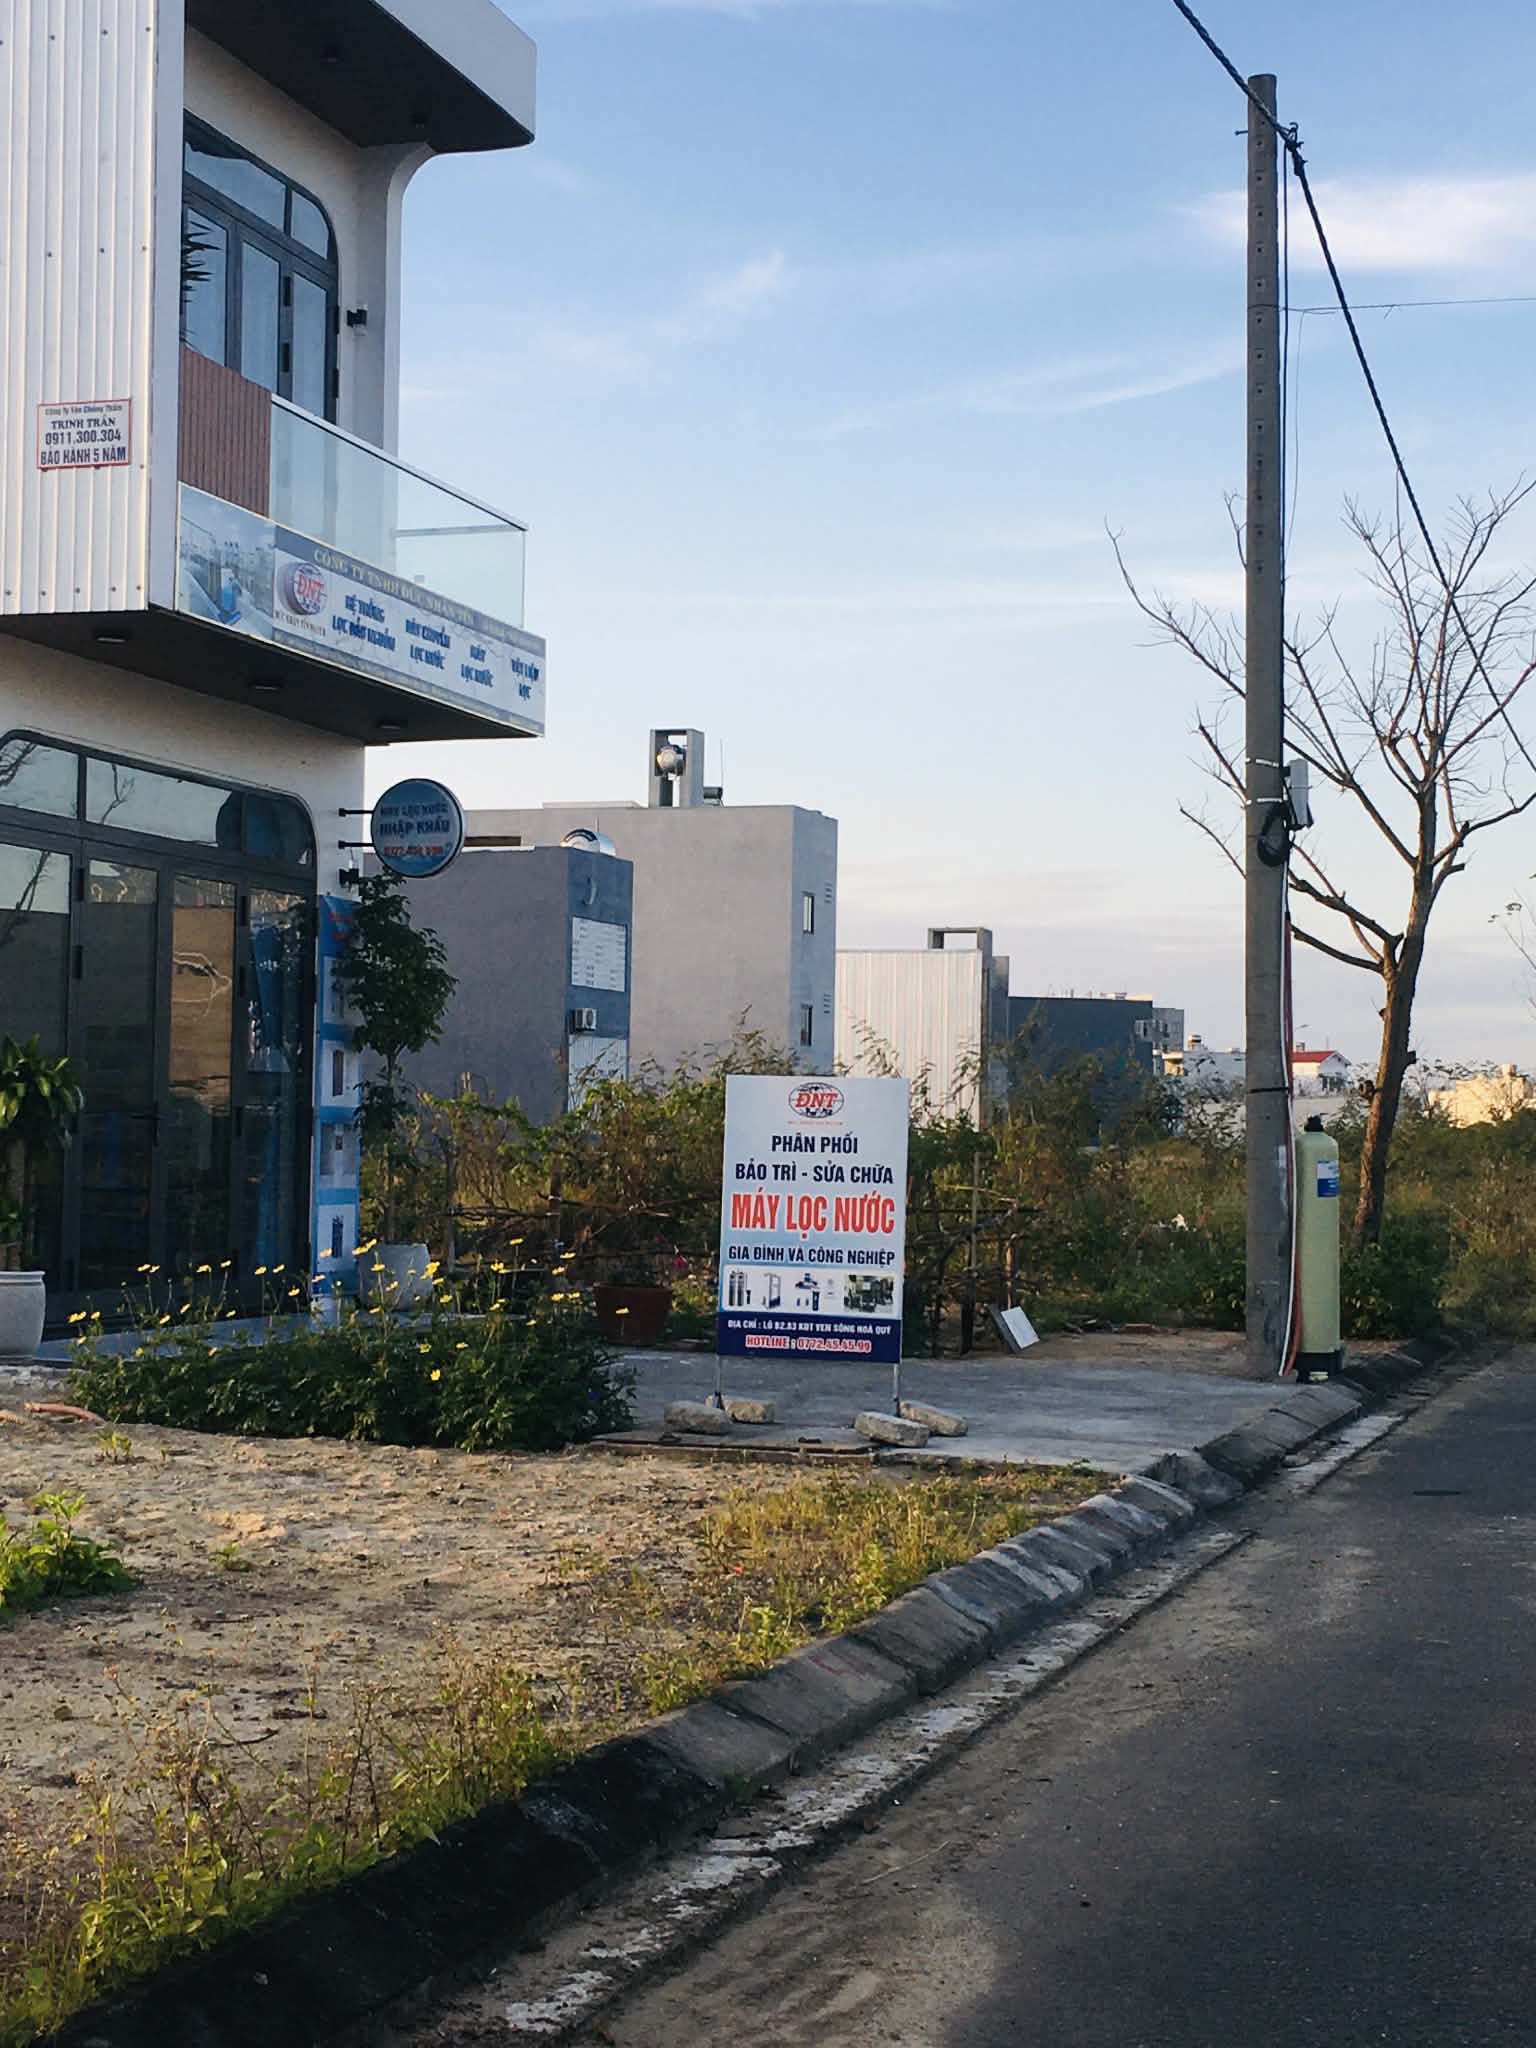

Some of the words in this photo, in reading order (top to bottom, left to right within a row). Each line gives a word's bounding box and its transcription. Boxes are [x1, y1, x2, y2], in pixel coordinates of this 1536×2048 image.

[45, 429, 121, 446] 0911.300.304
[93, 448, 100, 462] 5
[771, 1131, 815, 1153] PHÂN
[820, 1131, 858, 1155] PHỐI
[735, 1157, 768, 1181] BẢO
[771, 1160, 796, 1182] TRÌ
[813, 1160, 845, 1183] SỬA
[850, 1164, 894, 1185] CHỮA
[731, 1187, 781, 1230] MÁY
[786, 1194, 827, 1240] LỌC
[834, 1190, 895, 1234] NƯỚC
[728, 1245, 750, 1260] GIA
[753, 1243, 784, 1261] ĐÌNH
[788, 1245, 805, 1262] VÀ
[808, 1245, 843, 1264] CÔNG
[847, 1247, 895, 1268] NGHIỆP
[745, 1335, 790, 1348] HOTLINE
